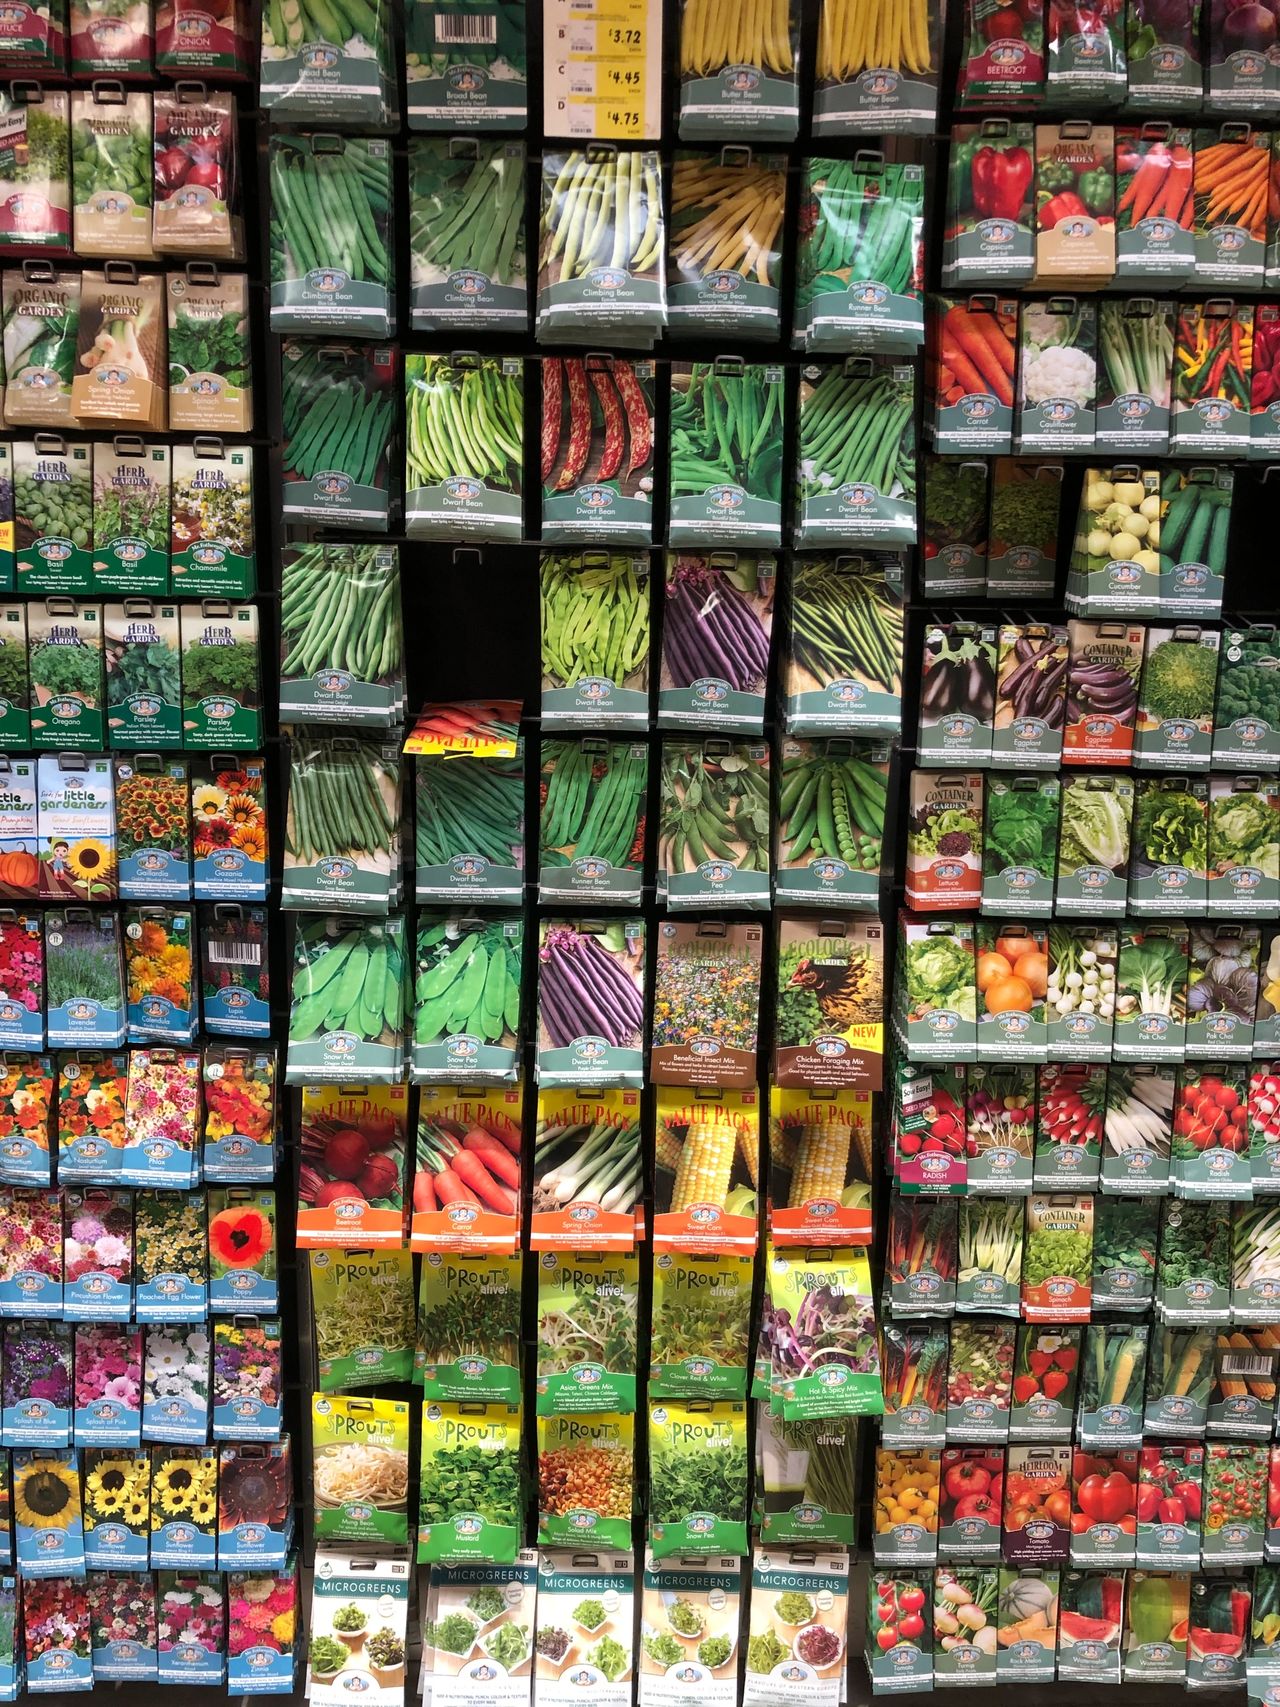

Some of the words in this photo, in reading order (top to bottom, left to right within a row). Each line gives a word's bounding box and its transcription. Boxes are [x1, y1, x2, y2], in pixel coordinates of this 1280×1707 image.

[559, 30, 565, 38] B
[609, 29, 641, 44] $3.72
[559, 65, 564, 74] C
[987, 66, 1027, 75] BEETROOT
[608, 71, 640, 85] $4.45
[558, 102, 565, 110] D
[608, 112, 639, 125] $4.75
[13, 289, 69, 303] ORGANIC
[302, 292, 333, 301] Climbing
[582, 289, 614, 298] Climbing
[616, 289, 634, 297] Bean
[698, 292, 728, 301] Climbing
[729, 292, 747, 300] Bean
[18, 307, 64, 316] GARDEN
[101, 307, 138, 315] GARDEN
[848, 304, 869, 313] Runner
[872, 305, 890, 313] Bean
[1039, 420, 1077, 428] Cauliflower
[38, 461, 67, 473] HERB
[117, 465, 145, 477] HERB
[33, 473, 71, 481] GARDEN
[196, 469, 224, 481] HERB
[112, 477, 149, 486] GARDEN
[191, 480, 227, 489] GARDEN
[576, 507, 597, 515] Dwarf
[706, 507, 726, 515] Dwarf
[728, 508, 745, 516] Bean
[839, 505, 858, 513] Dwarf
[190, 564, 227, 572] Chamomile
[1108, 583, 1141, 591] Cucumber
[1174, 585, 1206, 593] Cucumber
[51, 625, 77, 638] HERB
[128, 623, 155, 635] HERB
[204, 626, 231, 638] HERB
[47, 637, 81, 645] GARDEN
[1090, 656, 1124, 664] GARDEN
[314, 691, 333, 699] Dwarf
[335, 692, 352, 700] Bean
[576, 699, 595, 707] Dwarf
[597, 699, 613, 707] Bean
[692, 700, 711, 708] Dwarf
[52, 718, 81, 726] Oregano
[134, 716, 157, 724] Parsley
[208, 719, 231, 727] Parsley
[1167, 741, 1188, 749] Endive
[64, 791, 95, 801] little
[925, 790, 974, 803] CONTAINER
[41, 800, 107, 811] gardeners
[933, 802, 968, 810] GARDEN
[215, 870, 243, 878] Gazania
[317, 877, 337, 886] Dwarf
[1162, 887, 1183, 895] Lettuce
[814, 958, 848, 967] GARDEN
[853, 1027, 877, 1037] NEW
[447, 1055, 464, 1064] Snow
[674, 1055, 704, 1063] Beneficial
[705, 1056, 722, 1064] Insect
[796, 1056, 820, 1064] Chicken
[822, 1057, 851, 1066] Foraging
[596, 1105, 631, 1130] PACK
[715, 1105, 751, 1130] PACK
[1039, 1212, 1086, 1224] CONTAINER
[562, 1222, 583, 1230] Spring
[551, 1267, 625, 1292] SPROUTS
[596, 1285, 624, 1296] alive!
[827, 1386, 844, 1395] Spicy
[324, 1414, 395, 1436] SPROUTS
[663, 1420, 733, 1445] SPROUTS
[706, 1435, 732, 1447] alive!
[816, 1434, 845, 1446] alive!
[1019, 1459, 1062, 1474] HEIRLOOM
[1025, 1471, 1056, 1479] GARDEN
[456, 1534, 479, 1542] Mustard
[544, 1578, 625, 1589] MICROGREENS
[651, 1576, 731, 1587] MICROGREENS
[760, 1575, 840, 1589] MICROGREENS
[322, 1582, 401, 1594] MICROGREENS
